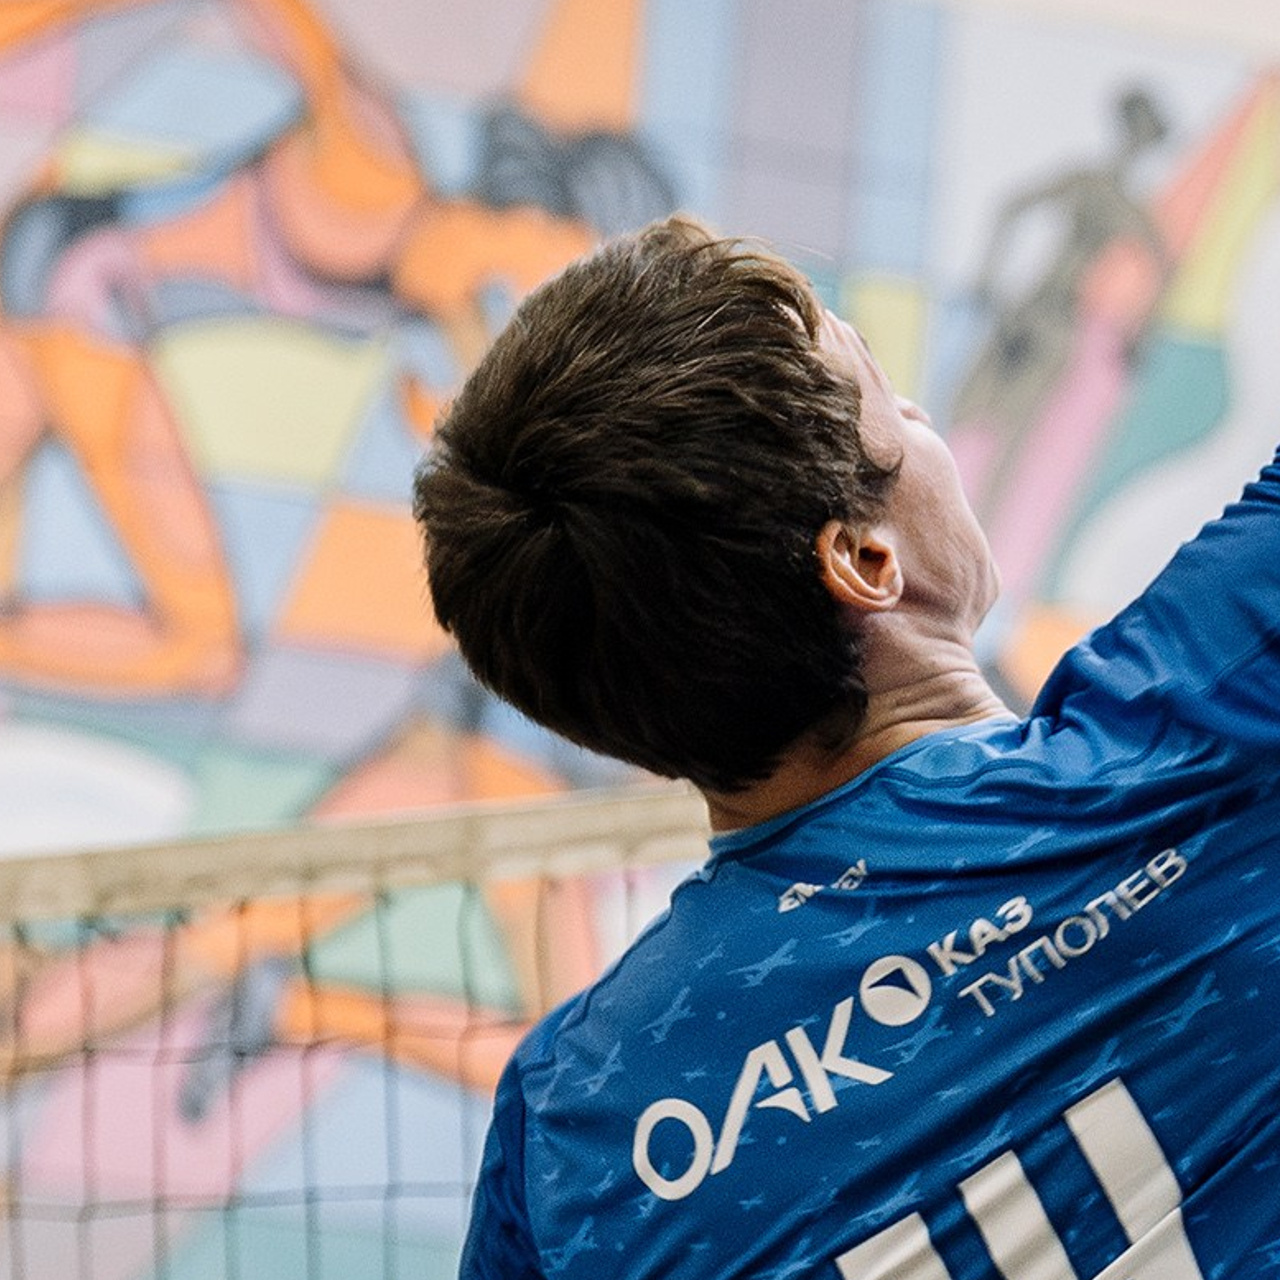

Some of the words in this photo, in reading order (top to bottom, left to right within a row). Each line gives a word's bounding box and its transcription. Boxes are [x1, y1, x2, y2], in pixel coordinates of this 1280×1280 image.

[926, 895, 1033, 976] КАЗ
[957, 848, 1188, 1017] ТУПОЛЕВ
[632, 996, 894, 1201] ОАК
